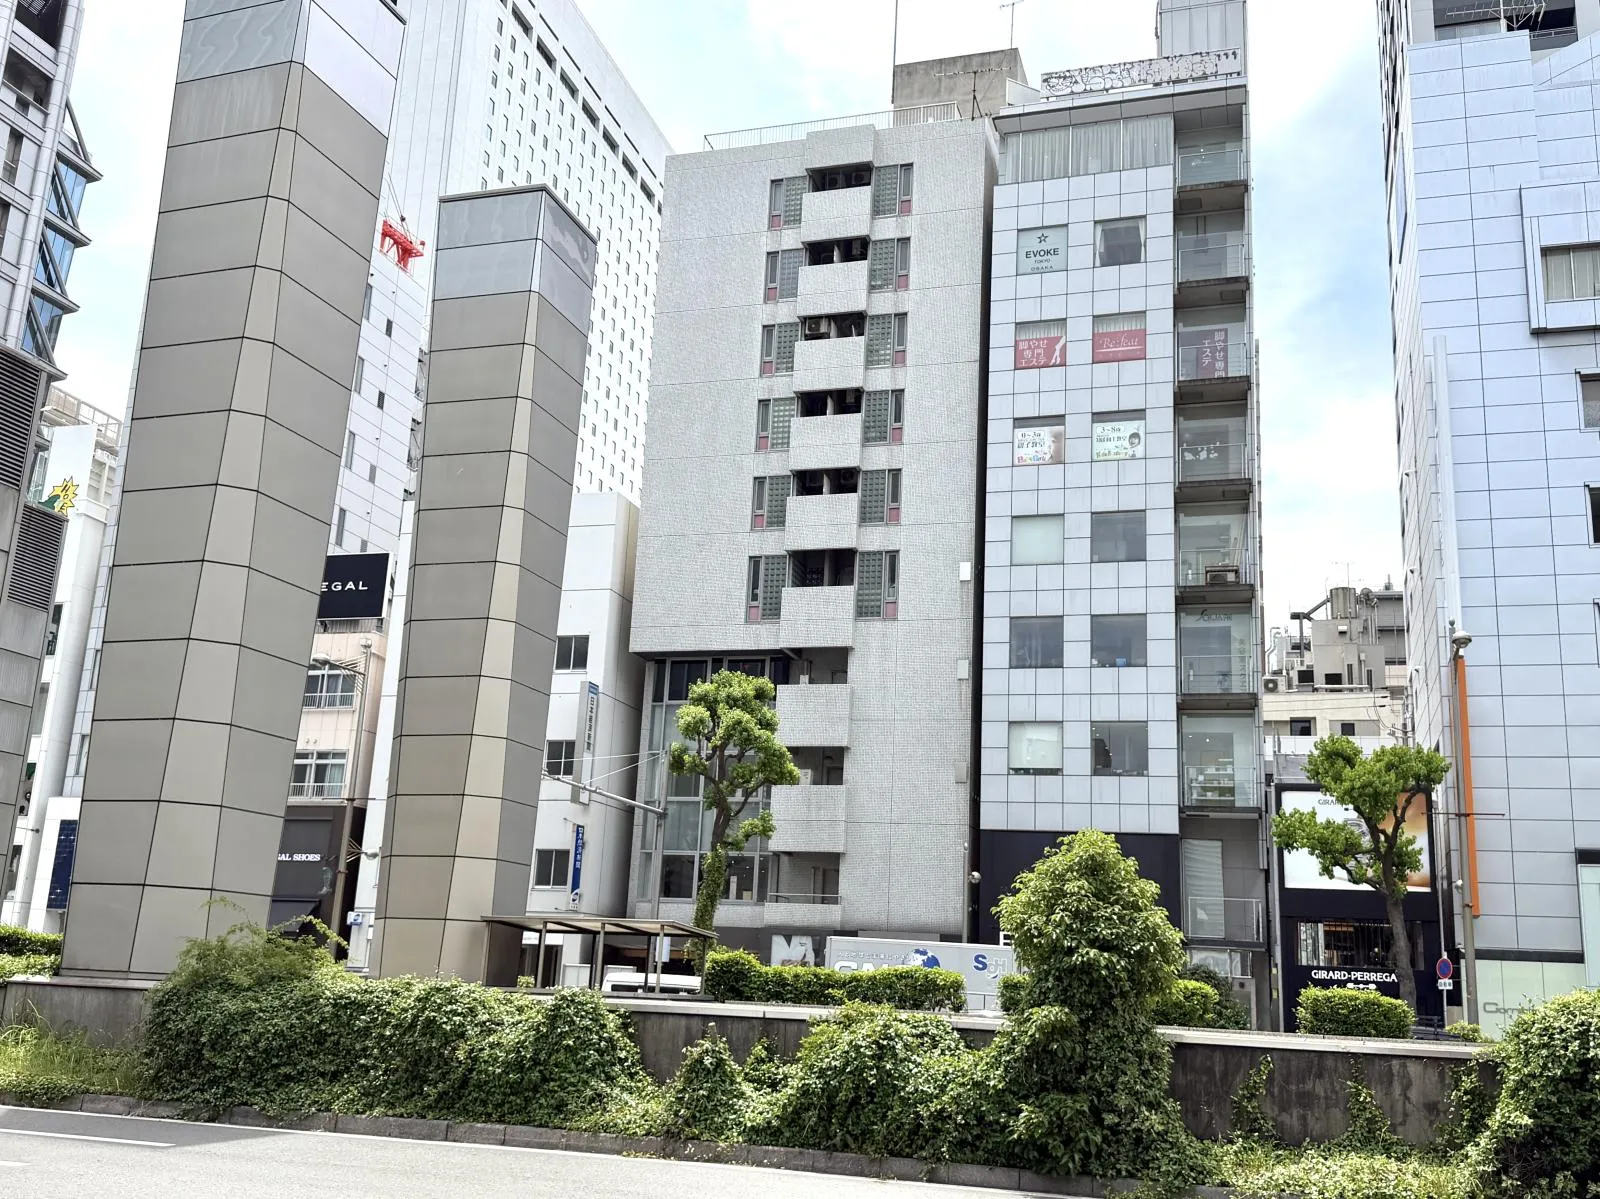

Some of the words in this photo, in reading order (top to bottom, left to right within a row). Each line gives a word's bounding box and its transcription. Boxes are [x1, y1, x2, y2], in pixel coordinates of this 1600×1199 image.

[1025, 247, 1060, 259] EVOKE
[1201, 339, 1212, 367] エステ
[1018, 357, 1047, 367] エステ
[292, 853, 321, 862] SHOES
